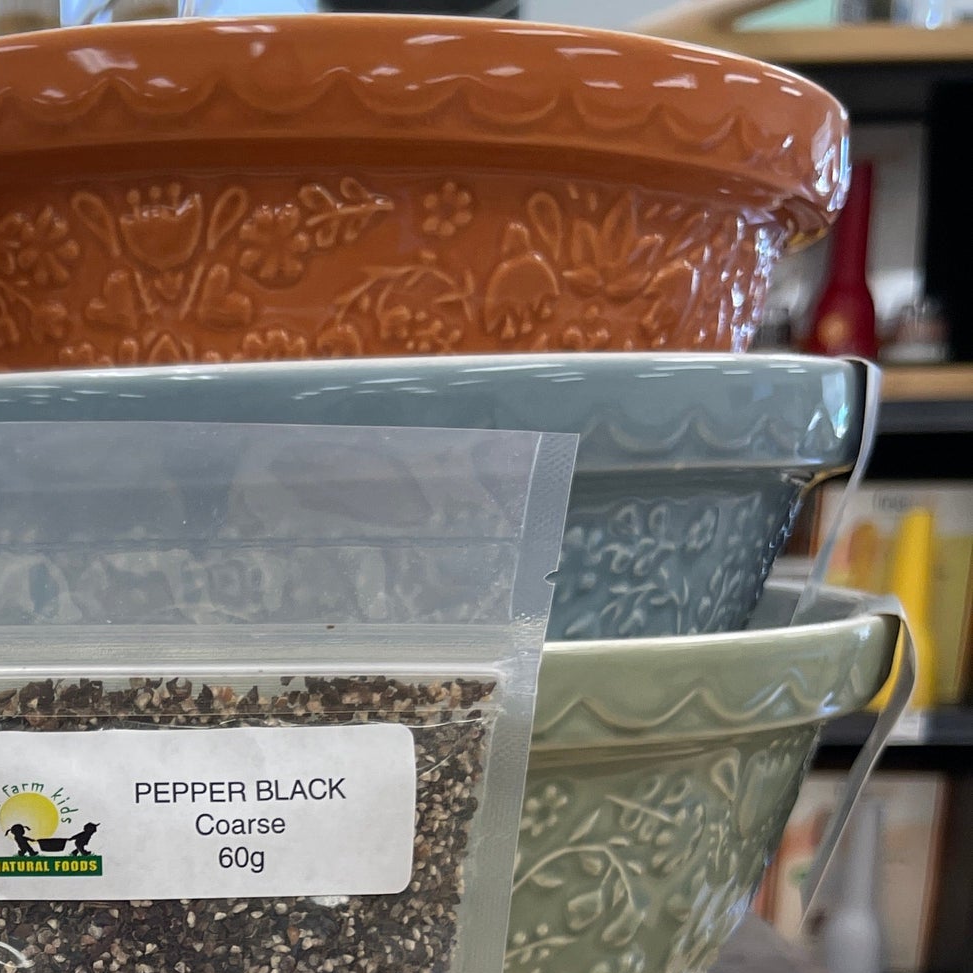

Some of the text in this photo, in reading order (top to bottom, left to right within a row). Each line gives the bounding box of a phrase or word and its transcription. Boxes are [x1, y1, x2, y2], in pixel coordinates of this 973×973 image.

[1, 782, 45, 797] farm
[50, 787, 79, 825] kids
[134, 777, 347, 804] PEPPER BLACK
[195, 813, 287, 836] Coarse
[54, 860, 98, 872] FOODS
[218, 846, 265, 874] 60g
